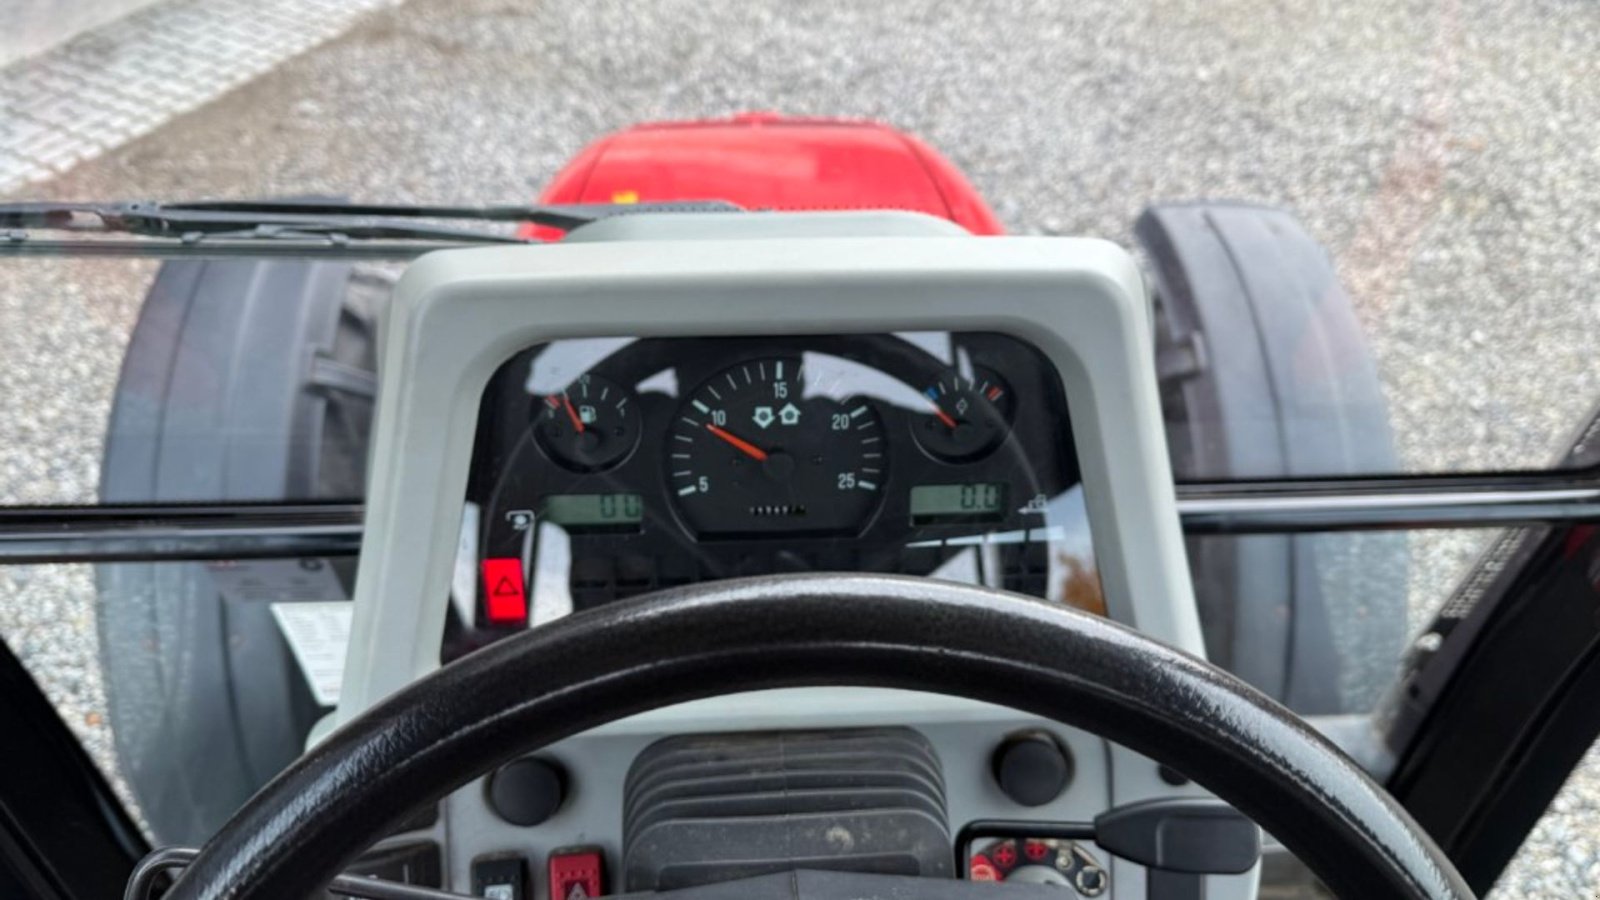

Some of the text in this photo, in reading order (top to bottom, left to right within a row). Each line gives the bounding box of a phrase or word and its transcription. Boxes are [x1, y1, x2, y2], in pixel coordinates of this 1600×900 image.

[773, 382, 788, 398] 15
[711, 411, 726, 426] 10
[831, 414, 849, 430] 20
[699, 477, 708, 492] 5
[838, 473, 855, 489] 25
